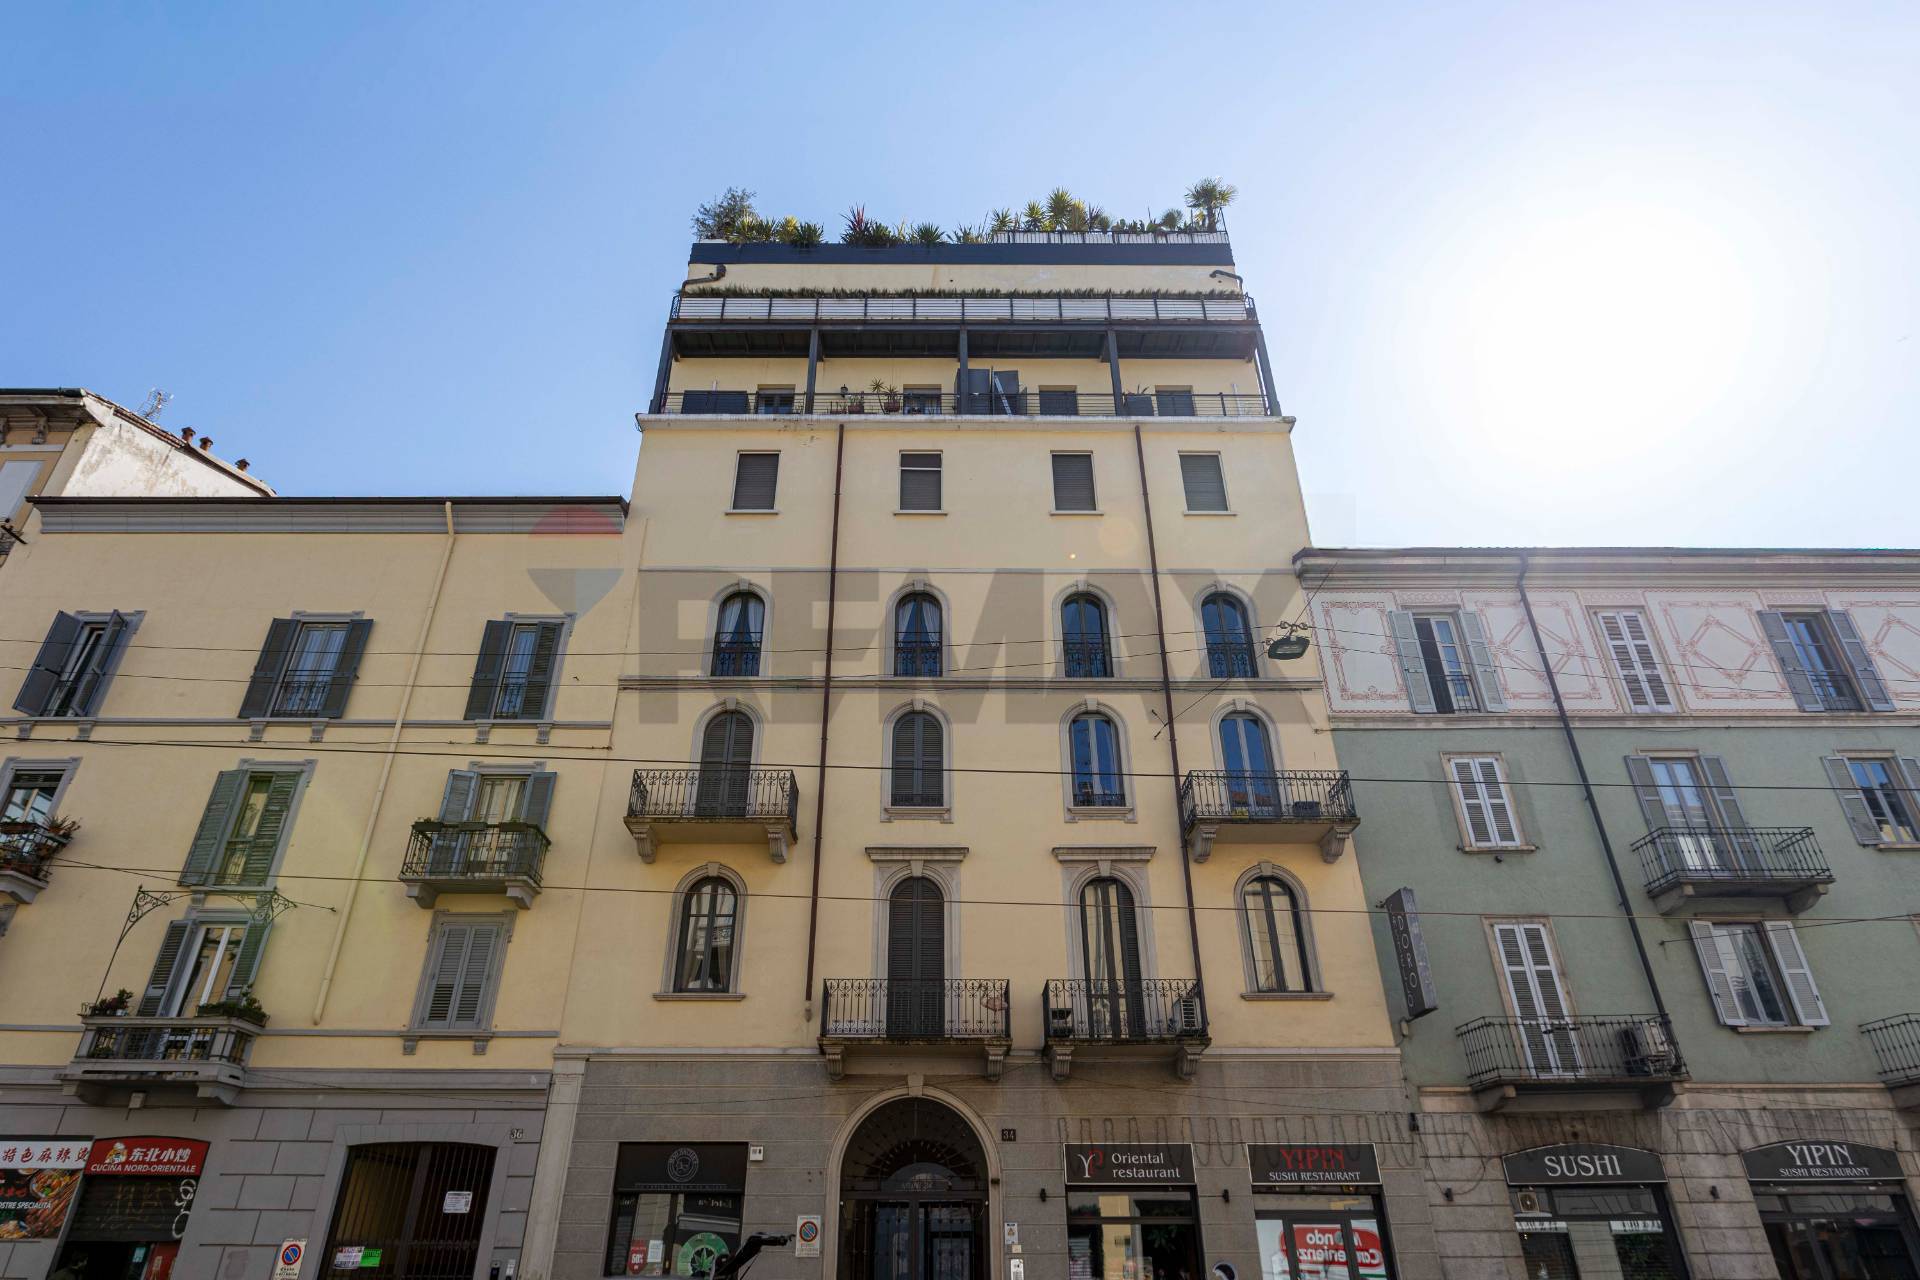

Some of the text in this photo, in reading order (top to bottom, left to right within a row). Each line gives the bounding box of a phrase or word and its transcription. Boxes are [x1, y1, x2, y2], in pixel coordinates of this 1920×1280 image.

[510, 1128, 524, 1139] 36
[1003, 1130, 1016, 1141] 34
[129, 1147, 192, 1163] 东北小炒
[1111, 1152, 1164, 1164] Oriental
[1279, 1148, 1345, 1169] YIPIN
[1786, 1145, 1854, 1166] YIPIN
[90, 1164, 197, 1174] CUCINA NORD-ORIENTALE
[1544, 1155, 1622, 1177] SUSHI
[1112, 1167, 1181, 1178] restaurant
[1269, 1171, 1361, 1182] SUSHI RESTAURANT
[1779, 1167, 1870, 1177] SUSHI RESTAURANT
